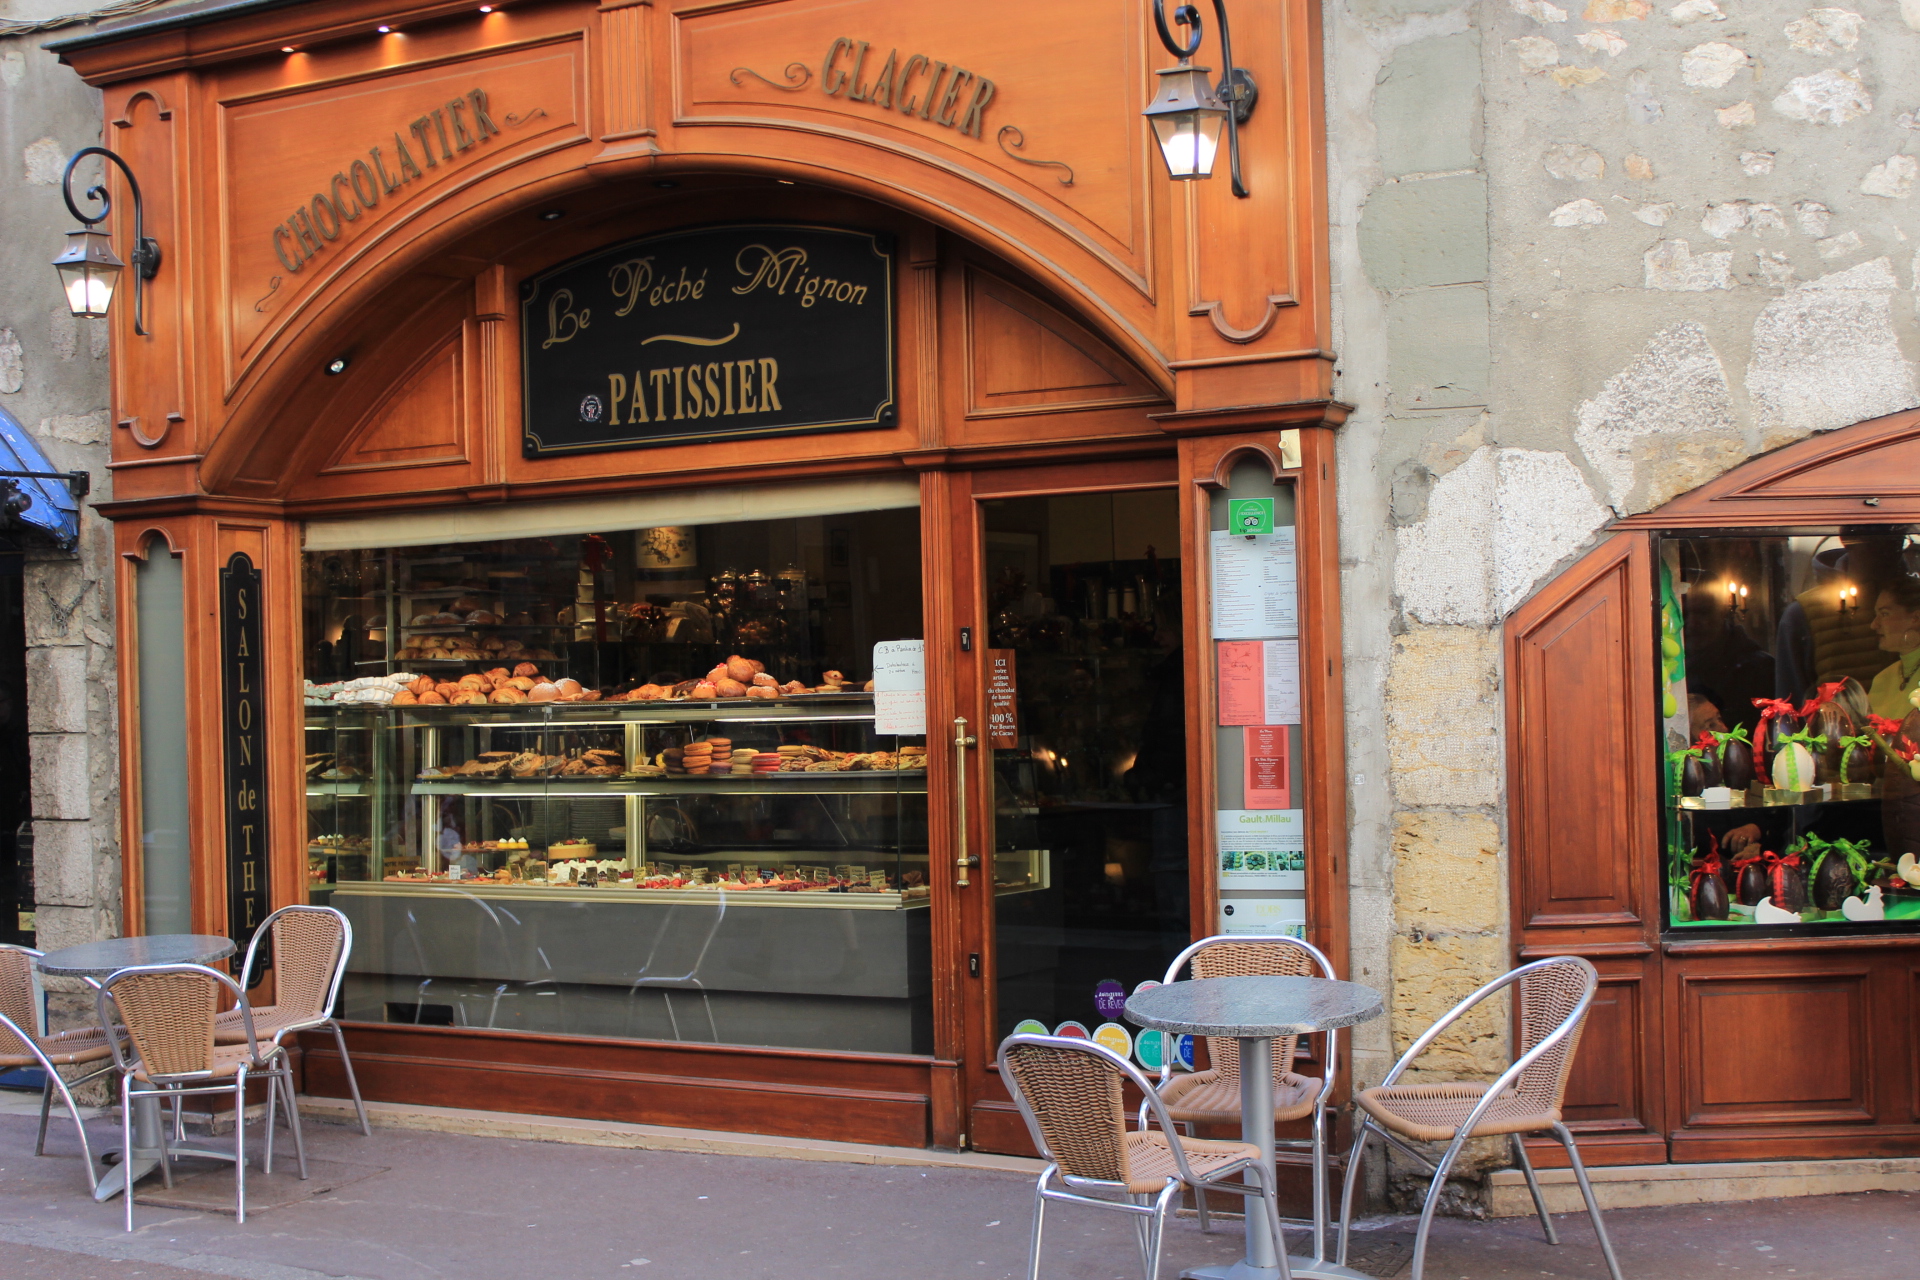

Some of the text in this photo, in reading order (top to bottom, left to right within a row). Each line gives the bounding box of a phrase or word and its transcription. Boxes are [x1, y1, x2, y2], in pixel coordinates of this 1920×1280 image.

[821, 36, 996, 140] GLACIER
[272, 87, 500, 273] CHOCOLATIER
[542, 243, 868, 350] Le Péché Mignon
[608, 356, 782, 426] PATISSIER
[993, 700, 1010, 708] qualité
[995, 659, 1006, 667] ICI
[237, 588, 256, 929] SALON de THE
[991, 713, 1004, 723] 100
